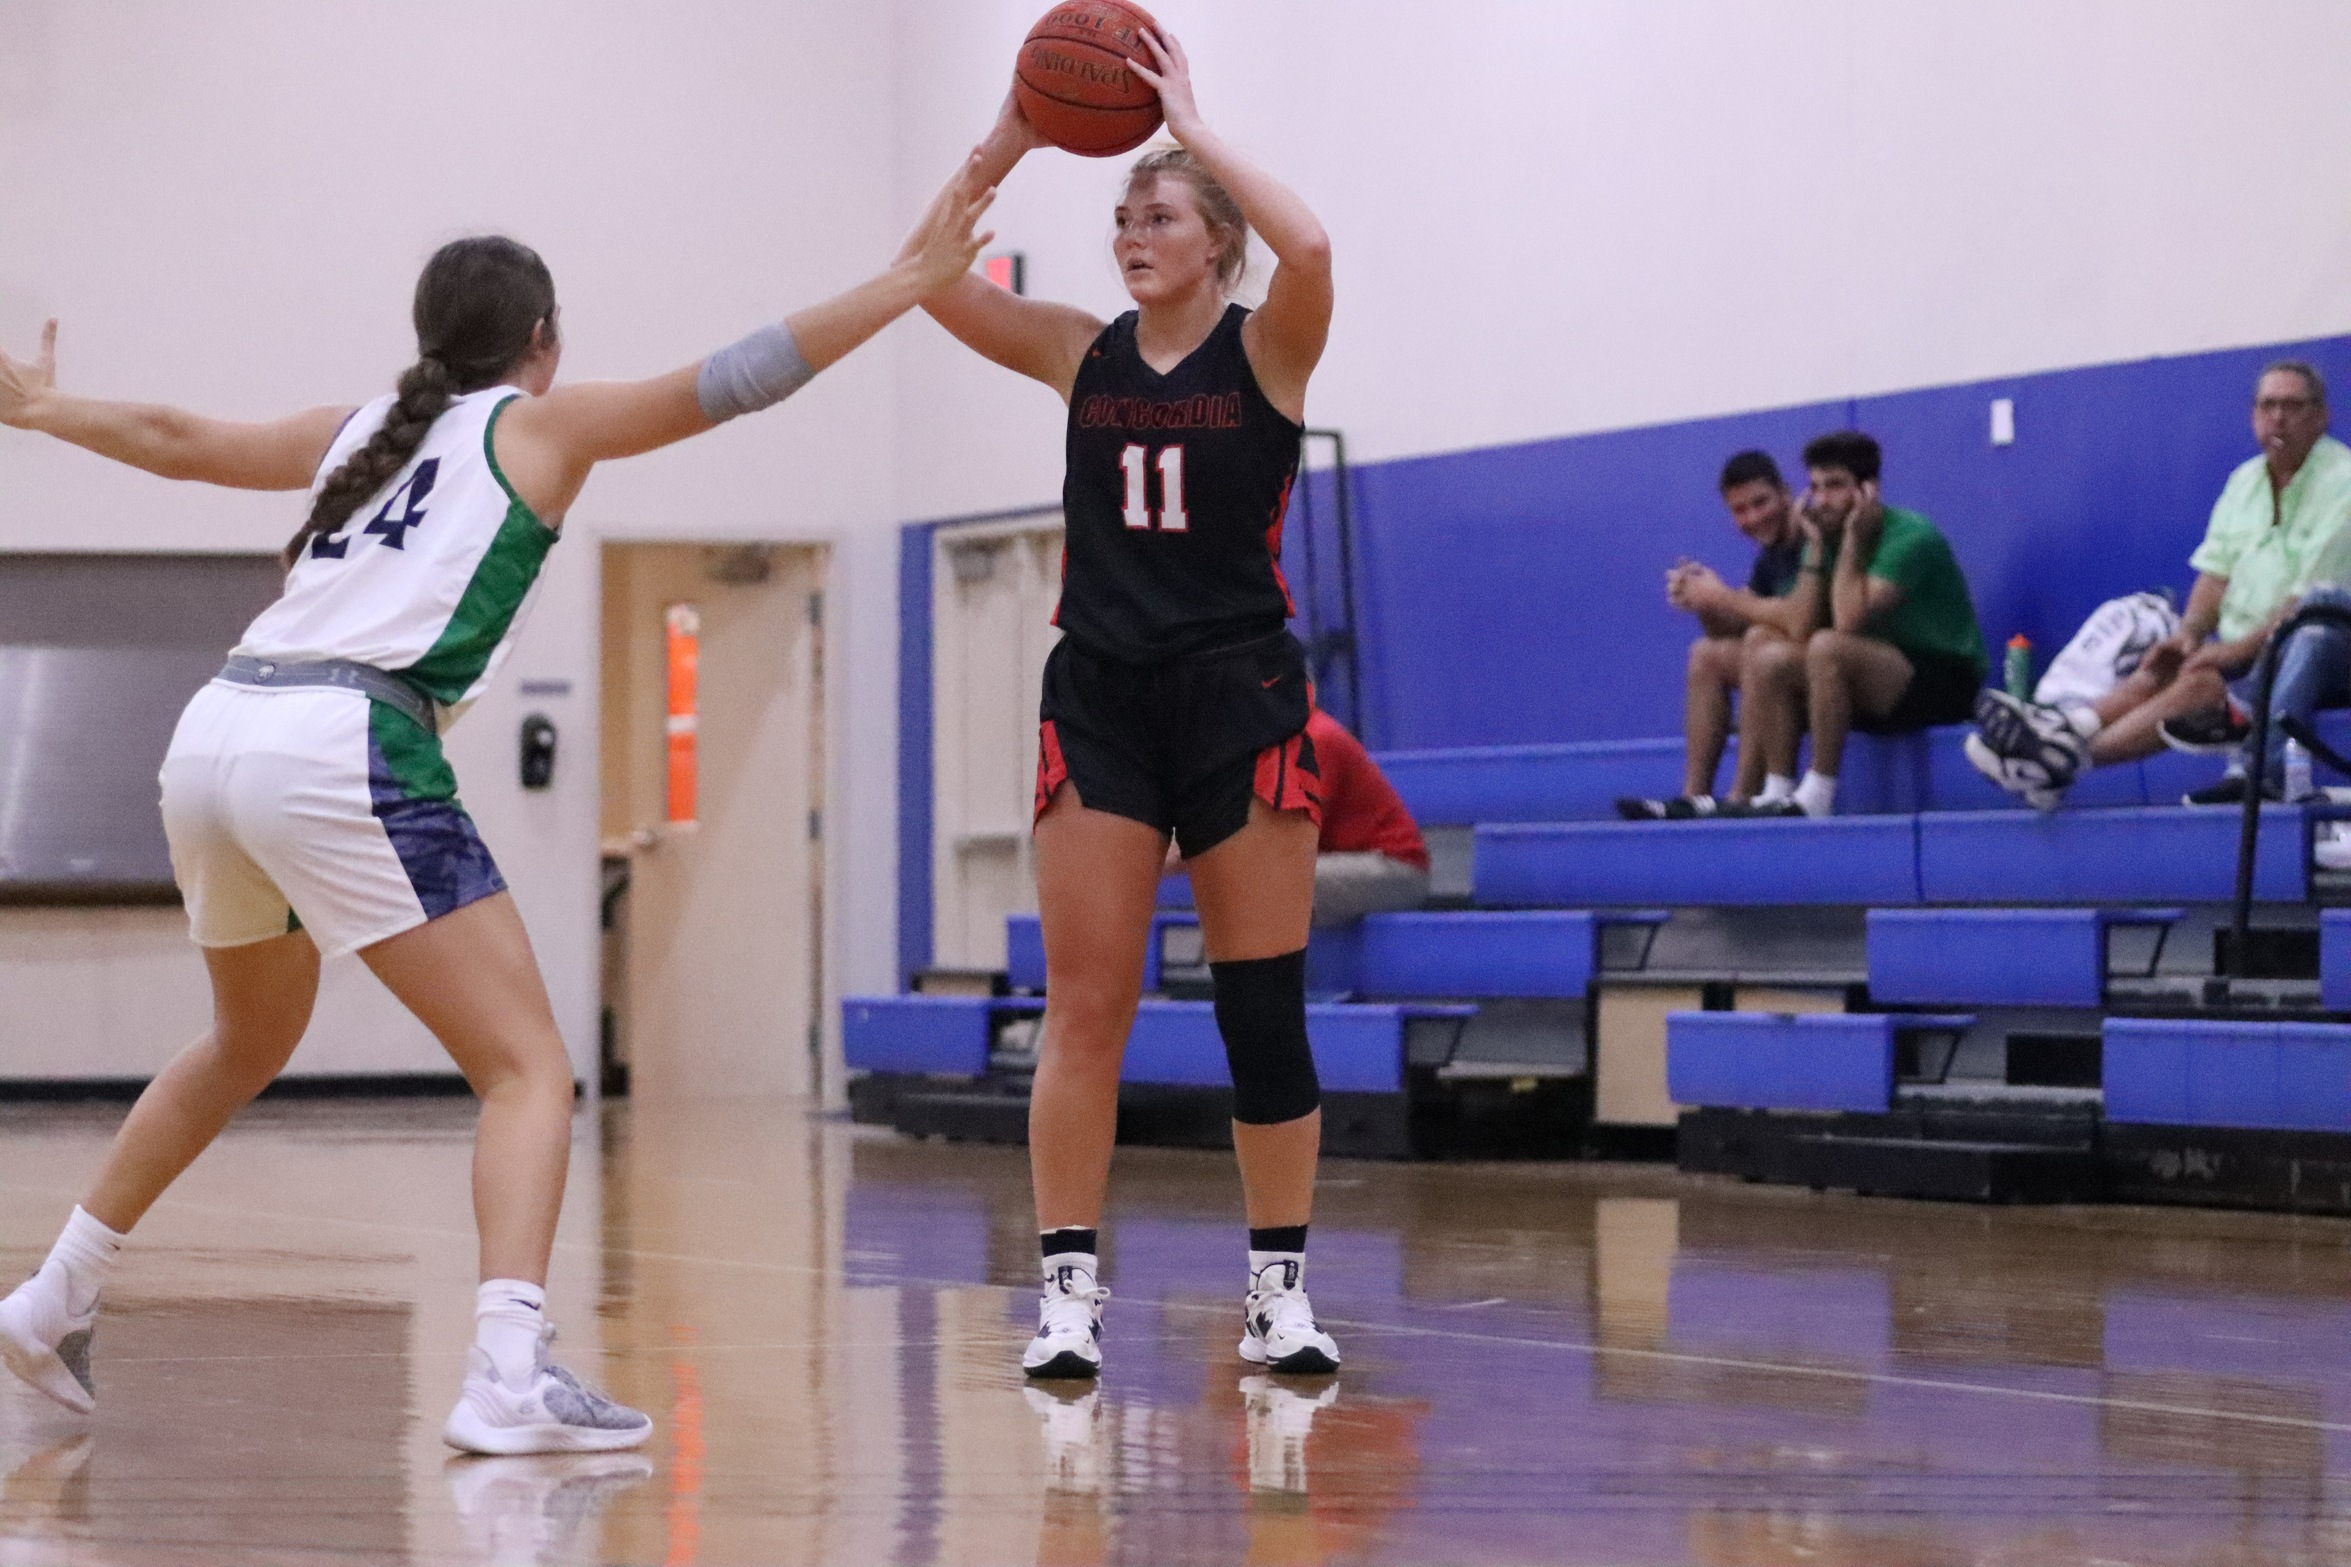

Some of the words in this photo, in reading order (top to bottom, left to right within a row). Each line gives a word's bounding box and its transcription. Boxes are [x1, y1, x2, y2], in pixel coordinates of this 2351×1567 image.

[1031, 47, 1134, 94] SPALDING
[1079, 391, 1242, 429] CONCORDIA
[1119, 442, 1190, 533] 11
